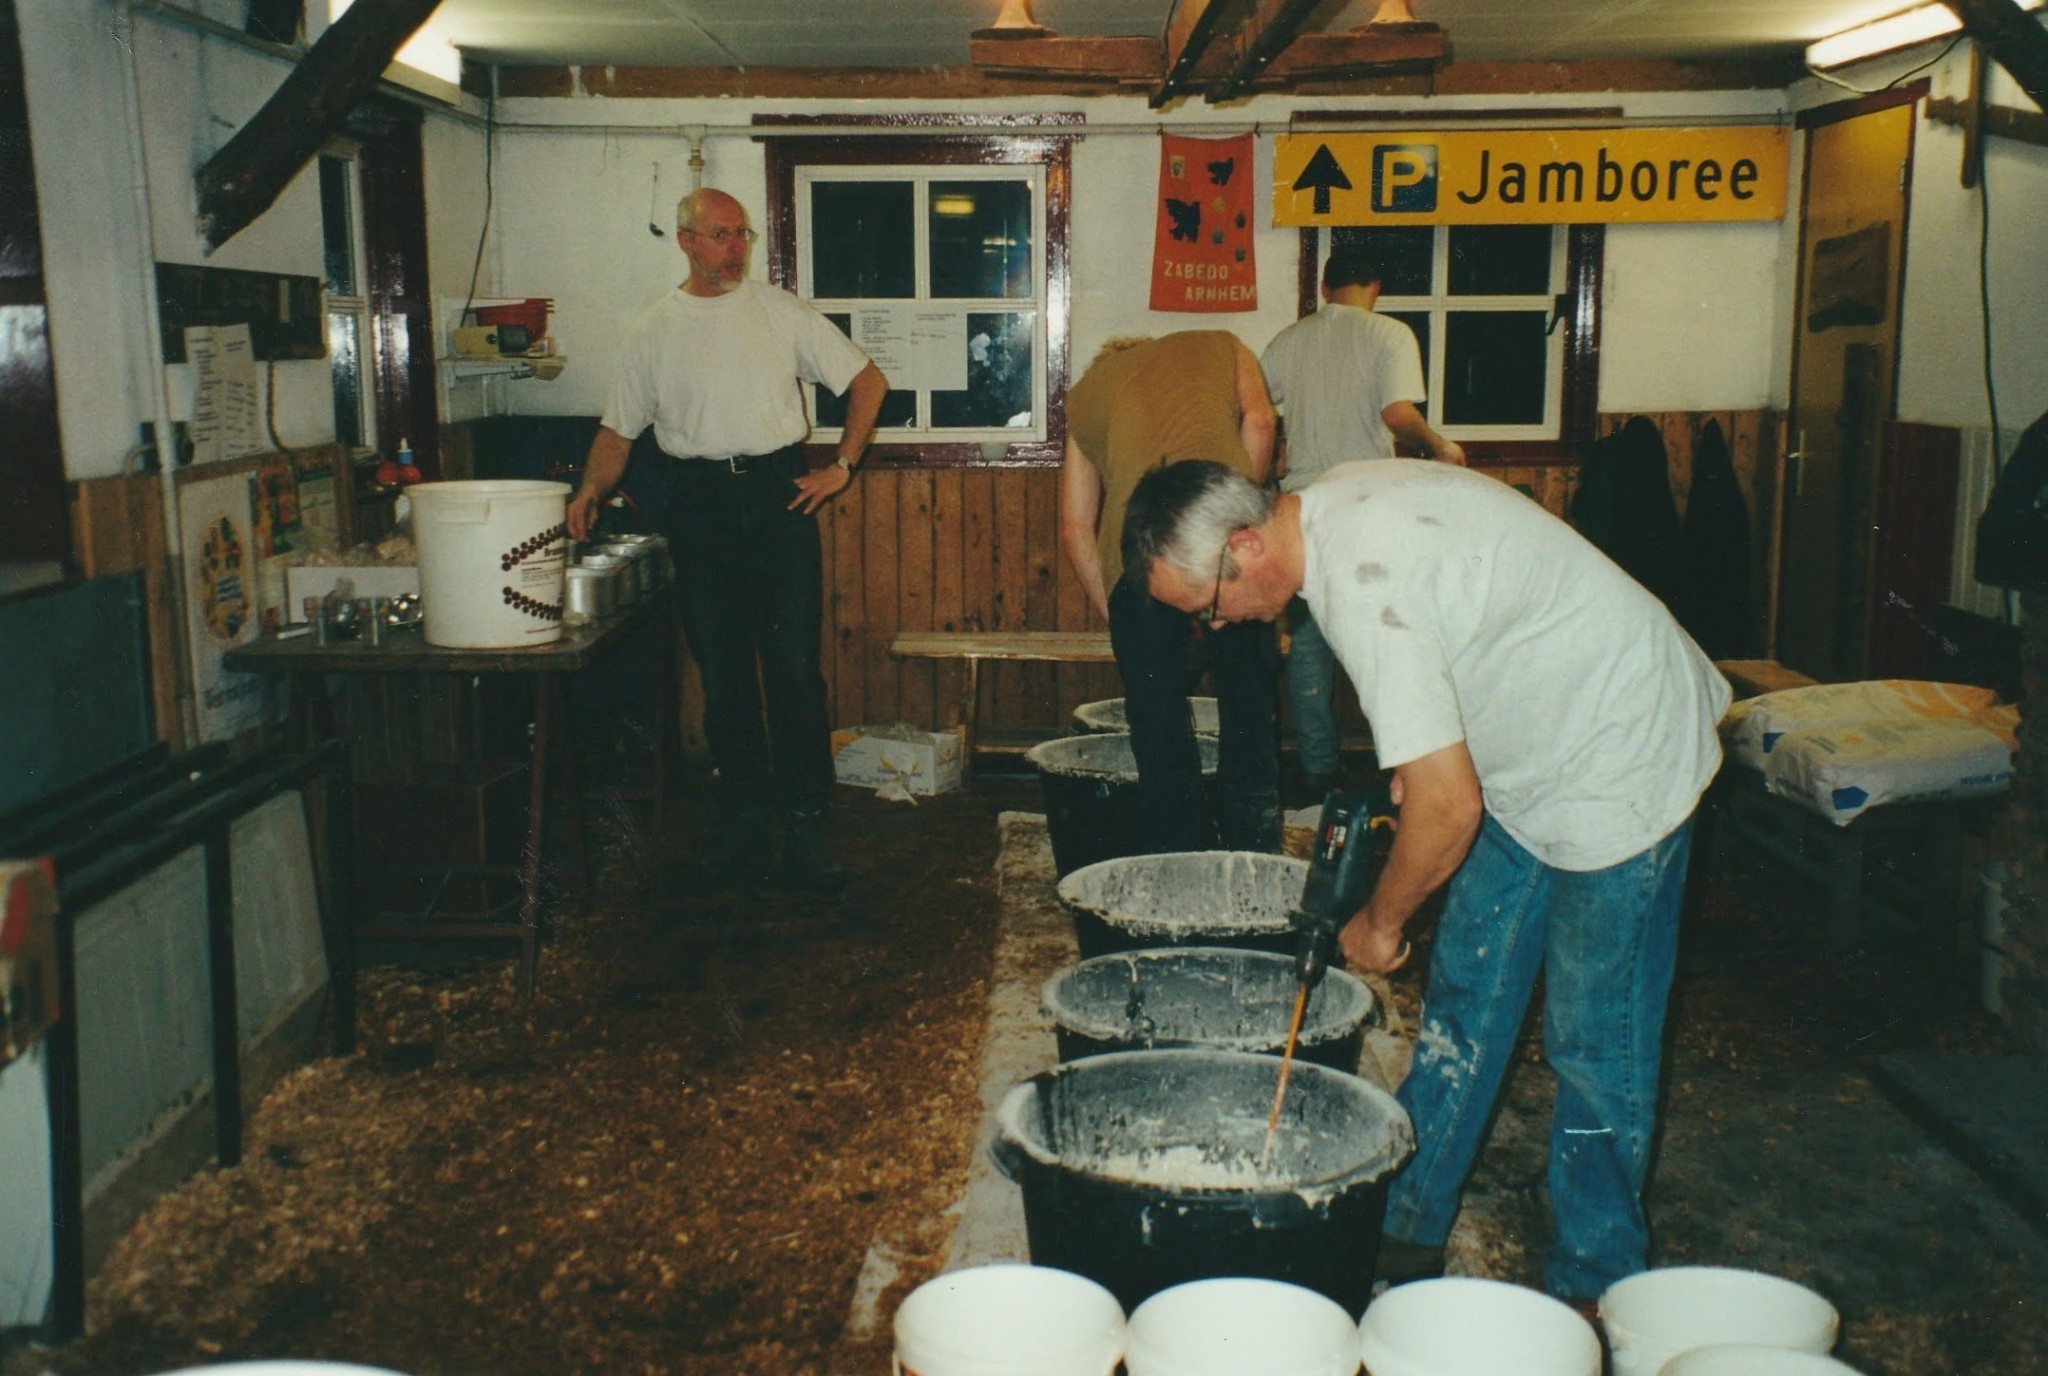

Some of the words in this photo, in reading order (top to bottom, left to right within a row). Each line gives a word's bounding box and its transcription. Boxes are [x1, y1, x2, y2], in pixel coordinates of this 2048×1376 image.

[1382, 151, 1426, 207] P
[1457, 147, 1758, 204] Jamboree
[1164, 260, 1228, 280] ZABEDO
[1185, 285, 1256, 301] ARNHEM
